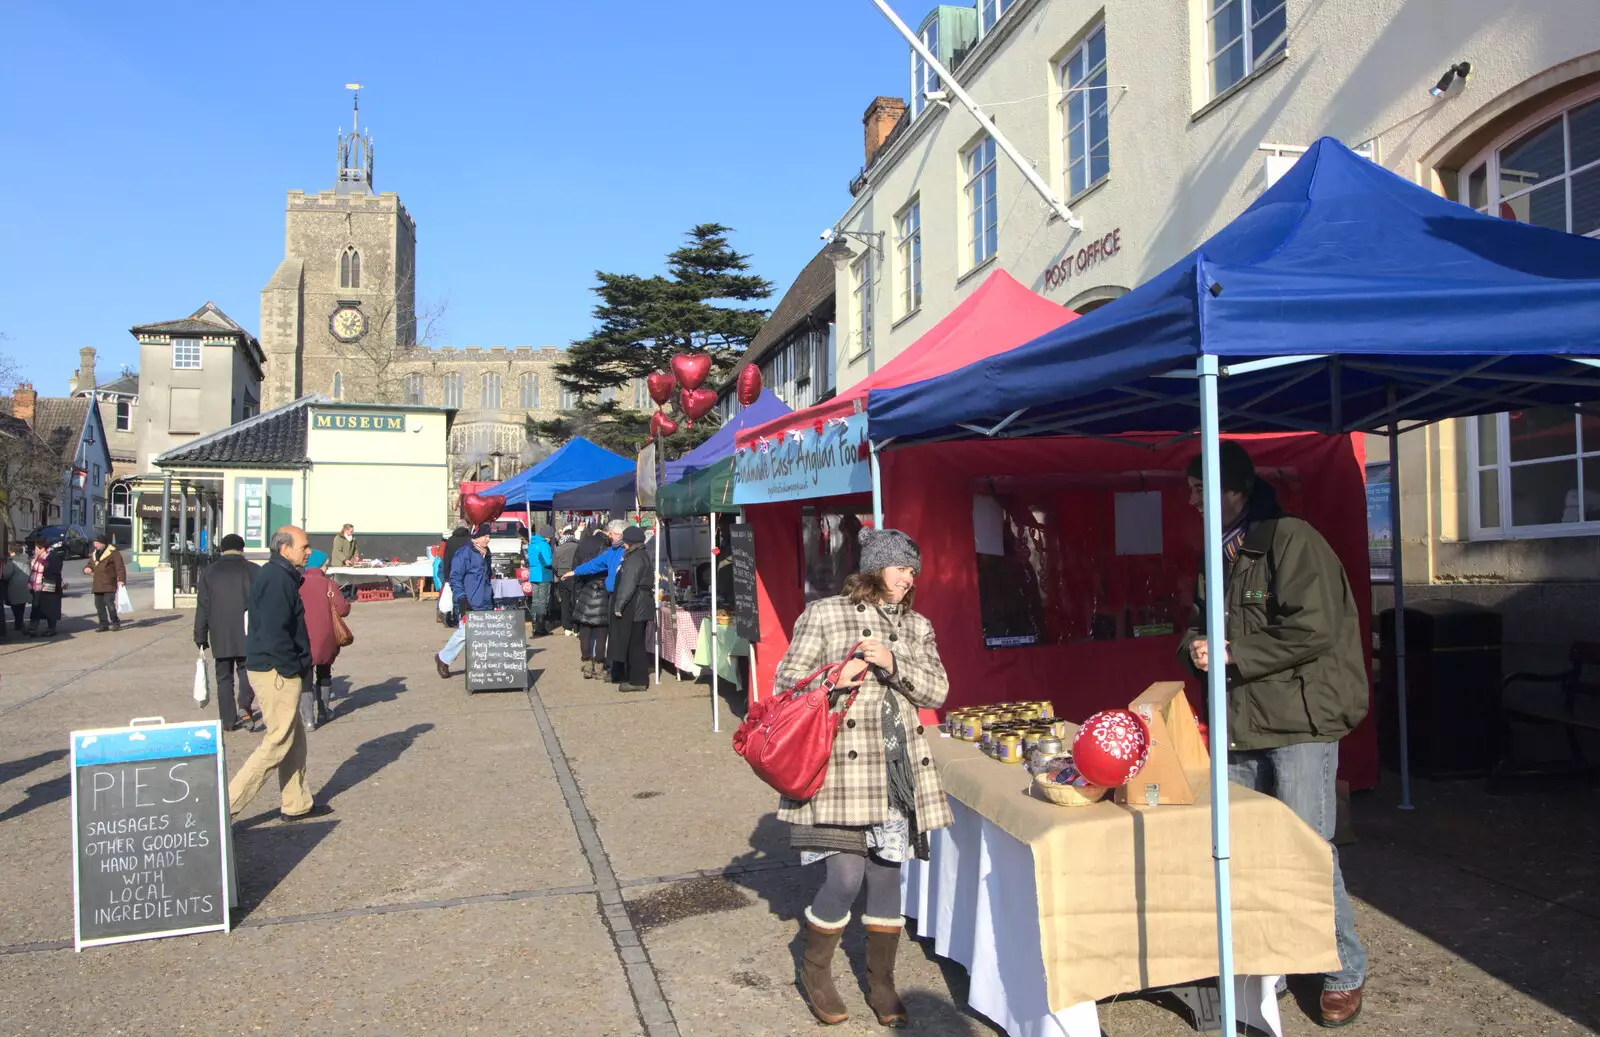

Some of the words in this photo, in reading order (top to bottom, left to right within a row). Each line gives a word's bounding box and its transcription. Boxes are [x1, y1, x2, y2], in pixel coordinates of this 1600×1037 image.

[1044, 255, 1074, 292] POST
[1077, 227, 1121, 271] OFFICE
[316, 415, 401, 429] MUSEUM
[770, 442, 794, 478] East
[796, 437, 836, 486] Anglian
[87, 815, 170, 836] SAUSAGES
[184, 812, 196, 829] &
[85, 837, 135, 856] OTHER
[142, 830, 210, 851] GOODIES
[100, 856, 138, 873] HAND
[144, 849, 186, 869] MADE
[122, 871, 163, 885] WITH
[110, 884, 172, 904] LOCAL
[94, 895, 213, 925] INGREDIENTS
